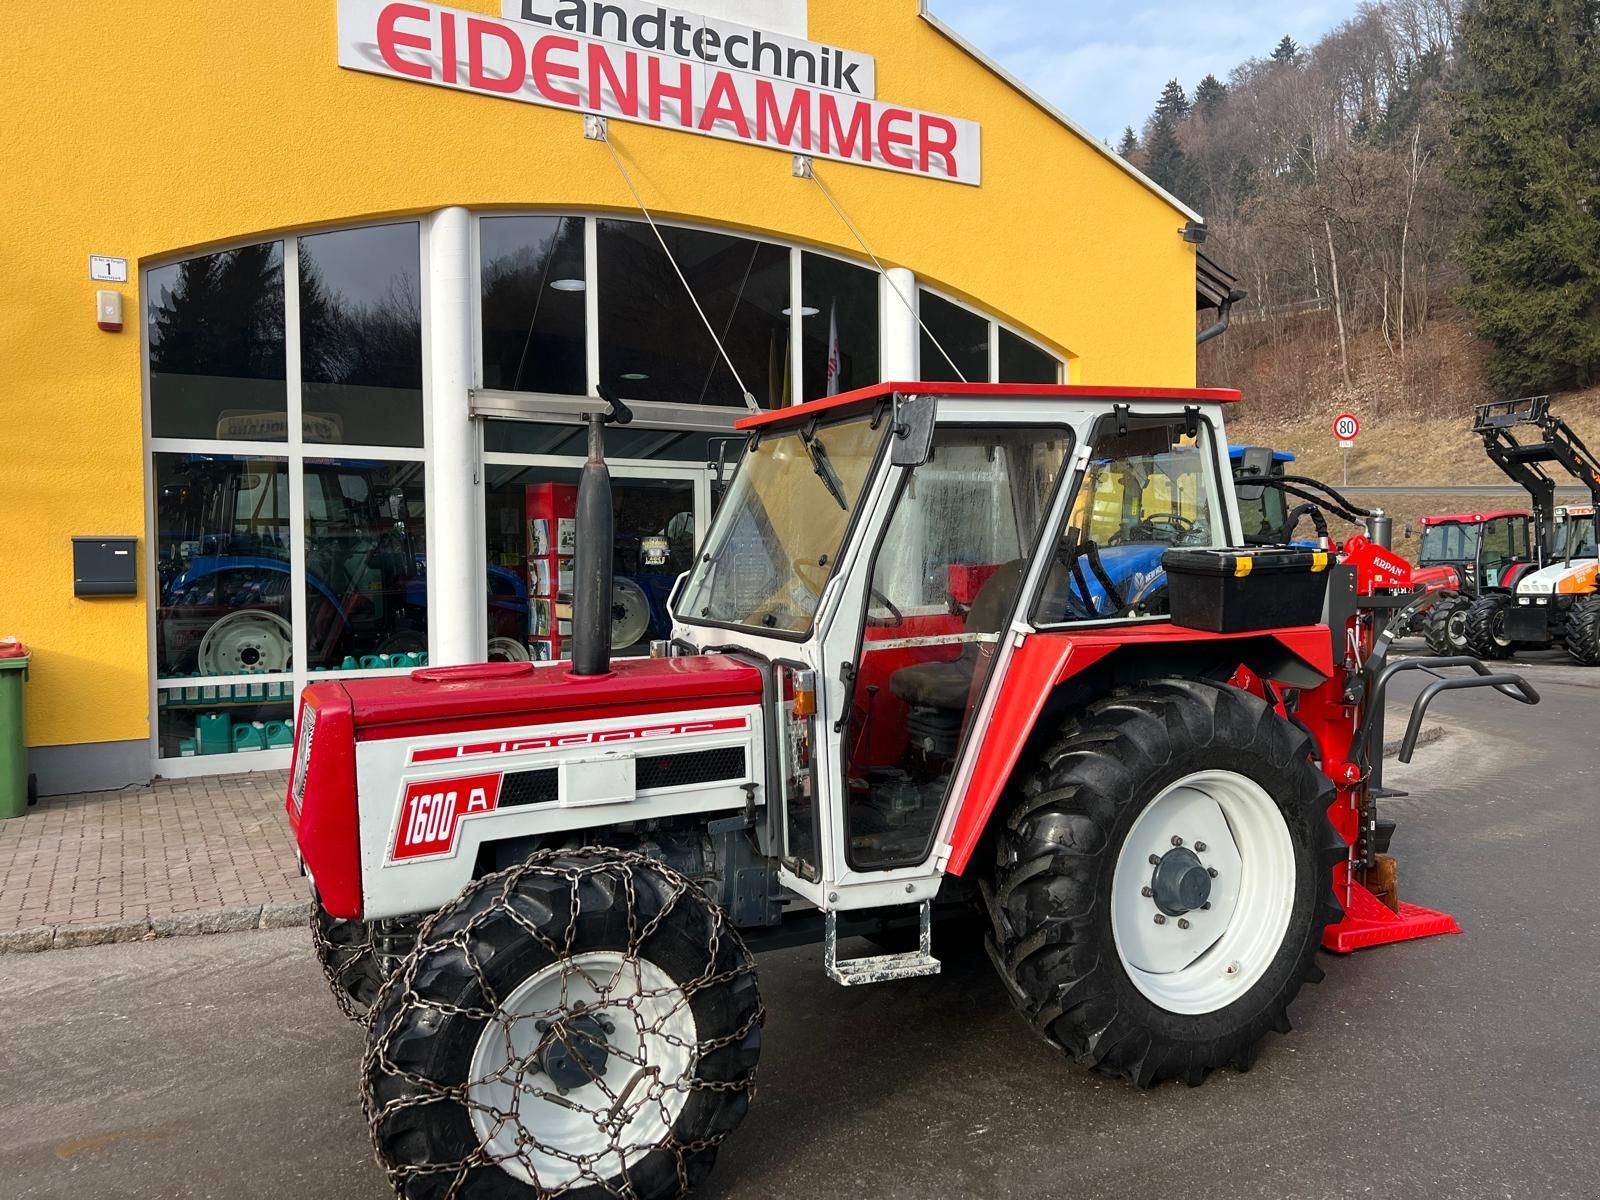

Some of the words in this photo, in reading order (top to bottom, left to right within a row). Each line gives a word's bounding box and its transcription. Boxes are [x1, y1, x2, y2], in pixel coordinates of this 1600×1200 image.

[521, 0, 860, 93] Landtechnik
[377, 3, 957, 177] EIDENHAMMER
[106, 263, 111, 275] 1
[1339, 420, 1353, 434] 80
[1373, 556, 1402, 576] KRPAN
[405, 791, 457, 846] 1600
[467, 788, 488, 811] A
